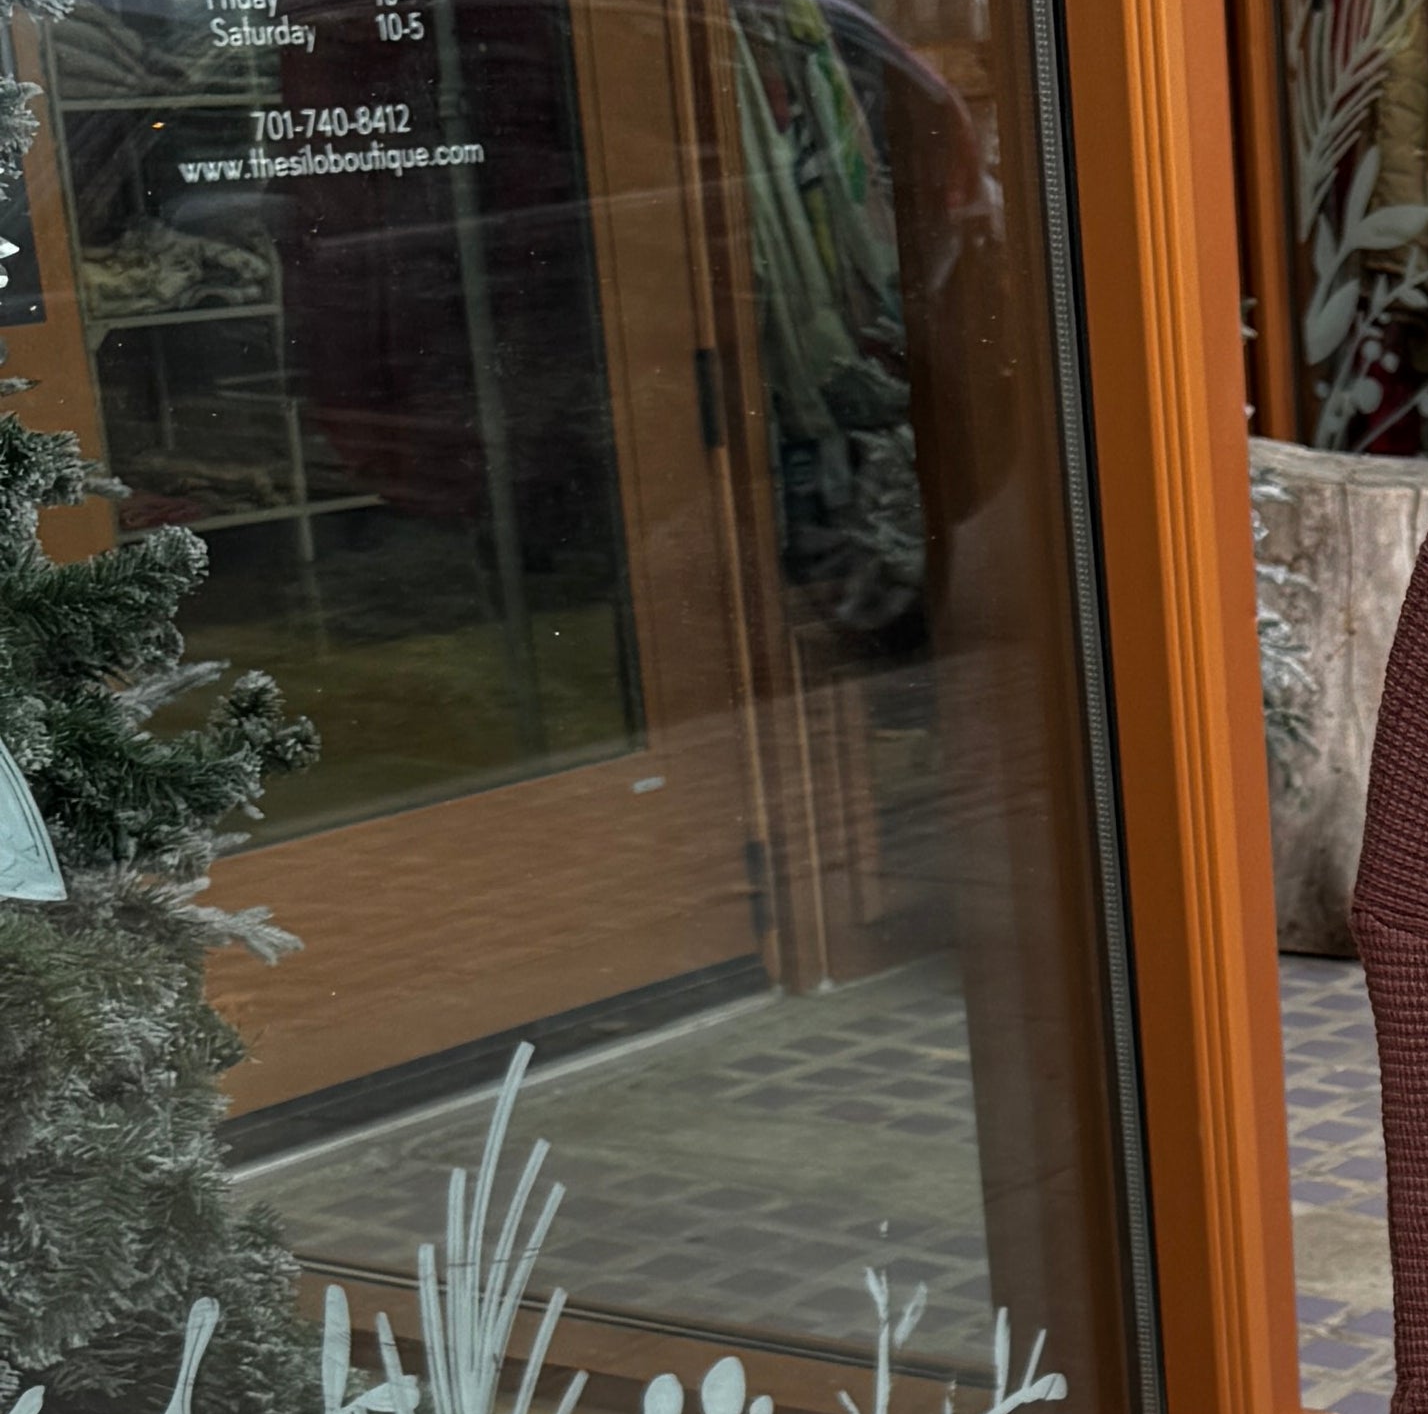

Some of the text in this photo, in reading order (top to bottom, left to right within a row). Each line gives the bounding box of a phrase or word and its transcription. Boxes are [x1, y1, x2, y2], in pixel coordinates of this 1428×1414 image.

[210, 11, 425, 53] Saturday 10-5
[251, 104, 412, 141] 701-740-8412
[178, 140, 485, 183] www.thesiloboutique.com
